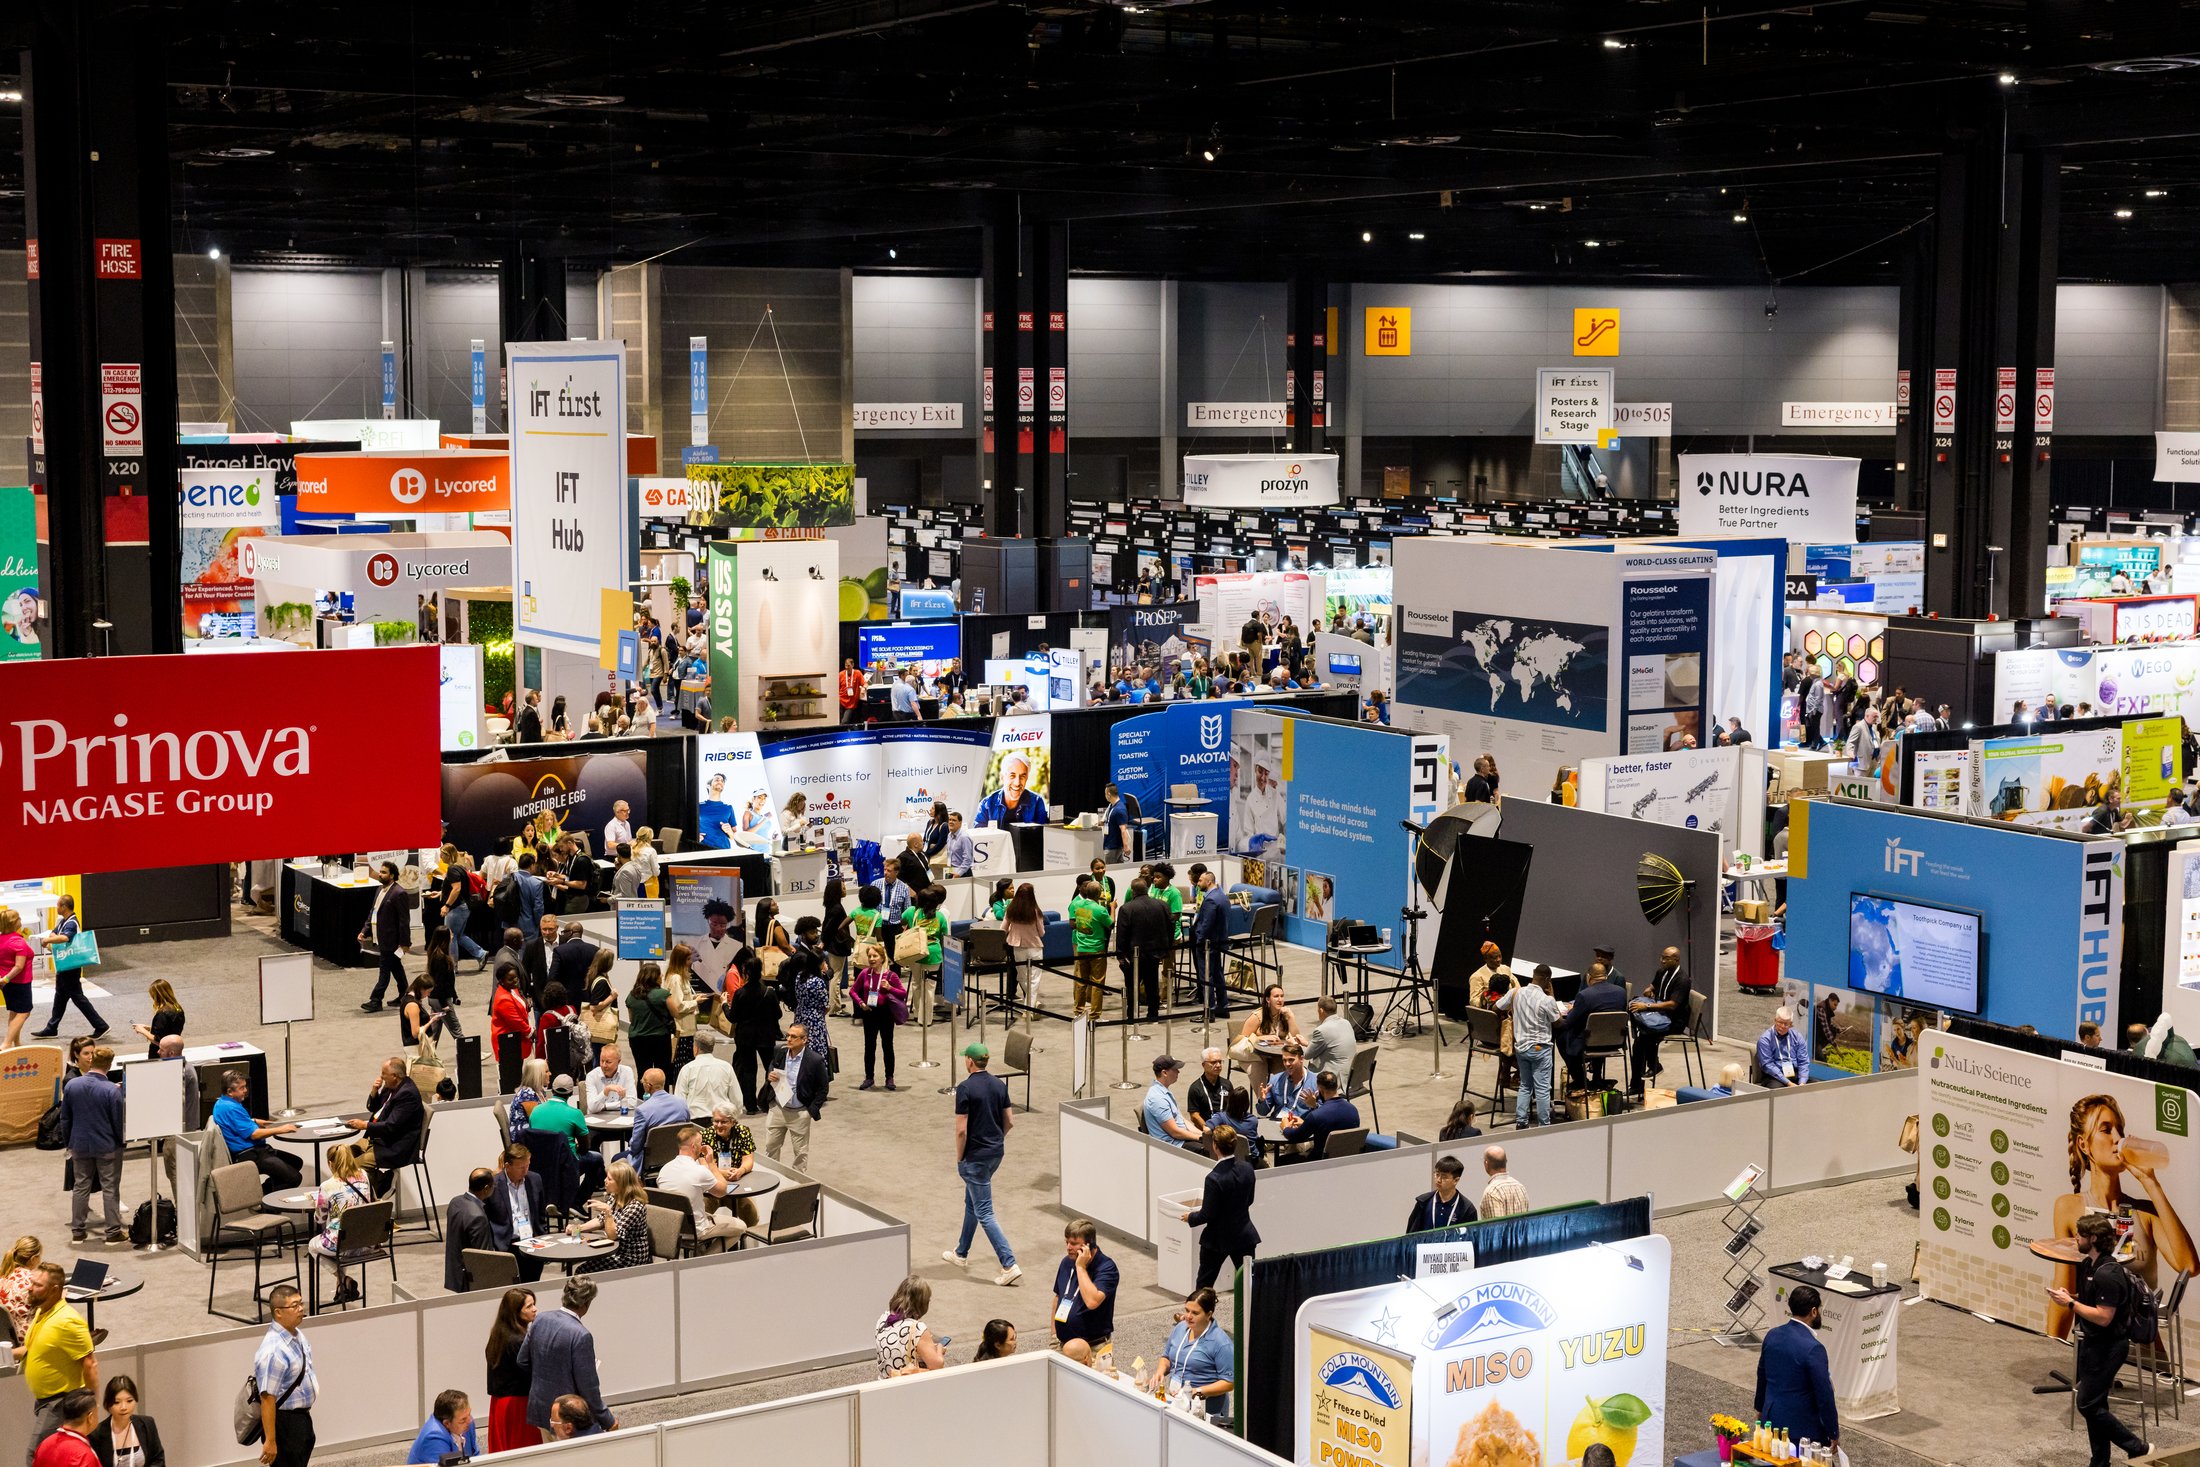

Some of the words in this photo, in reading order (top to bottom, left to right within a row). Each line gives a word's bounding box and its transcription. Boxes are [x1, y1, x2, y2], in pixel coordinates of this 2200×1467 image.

[102, 243, 132, 258] FIRE
[100, 260, 136, 274] HOSE
[104, 369, 111, 377] IN
[112, 369, 127, 377] CASE
[128, 369, 137, 377] OF
[1552, 378, 1566, 387] IFT
[1570, 377, 1599, 387] first
[530, 390, 551, 417] IFT
[558, 388, 602, 417] first
[1551, 397, 1588, 406] Posters
[1591, 398, 1599, 406] &
[853, 407, 918, 425] ergency
[922, 406, 955, 421] Exit
[1195, 405, 1287, 424] Emergency
[1550, 408, 1597, 418] Research
[1631, 408, 1642, 418] to
[1643, 407, 1671, 422] 505
[1790, 405, 1882, 423] Emergency
[1560, 420, 1590, 431] Stage
[105, 439, 113, 447] NO
[114, 439, 142, 447] SMOKING
[1935, 437, 1952, 447] X24
[1996, 440, 2012, 450] X24
[2035, 436, 2050, 446] X24
[2166, 447, 2200, 456] Functional
[108, 462, 140, 475] X20
[187, 455, 247, 469] Target
[253, 455, 297, 472] Flavo
[297, 478, 328, 496] ycored
[434, 475, 497, 497] Lycored
[556, 472, 579, 503] IFT
[1261, 478, 1308, 494] prozyn
[1720, 471, 1810, 497] NURA
[181, 478, 260, 507] eneo
[1719, 504, 1748, 515] Better
[1750, 505, 1810, 517] Ingredients
[1718, 518, 1737, 528] True
[1740, 518, 1778, 529] Partner
[552, 518, 584, 552] Hub
[1625, 557, 1677, 567] WORLD-CLASS
[1678, 555, 1714, 565] GELATINS
[406, 559, 469, 579] Lycored
[714, 559, 732, 596] US
[1630, 585, 1678, 595] Rousselot
[1135, 609, 1177, 627] PROSEP
[1407, 610, 1449, 622] Rousselot
[1629, 610, 1642, 618] Our
[1642, 609, 1665, 619] gelatins
[1665, 608, 1694, 617] transform
[1629, 618, 1646, 626] ideas
[1646, 617, 1657, 625] into
[1658, 616, 1685, 625] solutions,
[1685, 615, 1698, 623] with
[2137, 615, 2151, 628] IS
[2156, 612, 2193, 628] DEAD
[715, 597, 733, 659] SOY
[1629, 626, 1649, 636] quality
[1650, 625, 1662, 633] and
[1663, 624, 1690, 634] versatility
[1629, 635, 1645, 643] each
[1645, 633, 1678, 643] application
[1336, 682, 1359, 692] prozyn
[1002, 731, 1044, 743] RIAGEV
[1118, 730, 1151, 739] SPECIALTY
[1118, 738, 1143, 746] MILLING
[11, 713, 310, 792] Prinova
[705, 750, 752, 762] RIBOSE
[1118, 752, 1149, 760] TOASTING
[887, 767, 934, 778] Healthier
[937, 764, 968, 776] Living
[1118, 766, 1144, 775] CUSTOM
[1413, 744, 1438, 802] IFT
[1613, 762, 1643, 774] better,
[1646, 761, 1673, 771] faster
[1972, 749, 1980, 787] Agridient
[790, 773, 852, 785] Ingredients
[855, 771, 871, 781] for
[1118, 773, 1149, 782] BLENDING
[543, 786, 555, 795] the
[513, 793, 566, 820] INCREDIBLE
[568, 789, 587, 806] EGG
[809, 799, 851, 811] sweetR
[905, 796, 933, 804] Manno
[1299, 793, 1310, 804] IFT
[1310, 796, 1328, 807] feeds
[1329, 798, 1340, 809] the
[1341, 800, 1362, 813] minds
[1363, 804, 1377, 817] that
[22, 791, 165, 826] NAGASE
[176, 790, 274, 816] Group
[1299, 806, 1314, 818] feed
[1314, 808, 1326, 819] the
[1326, 810, 1346, 823] world
[1347, 816, 1368, 828] across
[1298, 819, 1310, 830] the
[1310, 821, 1332, 836] global
[1333, 825, 1348, 837] food
[1348, 831, 1375, 844] system.
[1884, 845, 1925, 877] IFT
[675, 884, 713, 893] Transforming
[791, 879, 815, 892] BLS
[2084, 851, 2113, 925] IFT
[676, 896, 708, 904] Agriculture
[691, 890, 714, 898] through
[1913, 914, 1937, 925] Toothpick
[1938, 918, 1962, 931] Company
[1963, 923, 1972, 931] Ltd
[2080, 929, 2110, 1028] HUB
[1931, 1078, 1975, 1096] Nutraceutical
[1976, 1090, 2007, 1105] Patented
[2007, 1099, 2048, 1115] Ingredients
[2161, 1091, 2181, 1100] Certified
[2166, 1102, 2177, 1117] B
[2012, 1169, 2035, 1180] astrion
[2012, 1204, 2039, 1217] Osteosine
[1422, 1253, 1443, 1264] MIYAKO
[1444, 1252, 1469, 1263] ORIENTAL
[1429, 1263, 1449, 1275] FOODS,
[1476, 1284, 1552, 1323] MOUNTAIN
[1558, 1321, 1646, 1370] YUZU
[1445, 1346, 1533, 1394] MISO
[1321, 1354, 1347, 1379] COLD
[1351, 1355, 1400, 1406] MOUNTAIN
[1333, 1399, 1361, 1417] Freeze
[1363, 1409, 1386, 1427] Dried
[1316, 1417, 1331, 1426] kosher
[1336, 1417, 1382, 1454] MISO
[1320, 1441, 1384, 1467] POW
